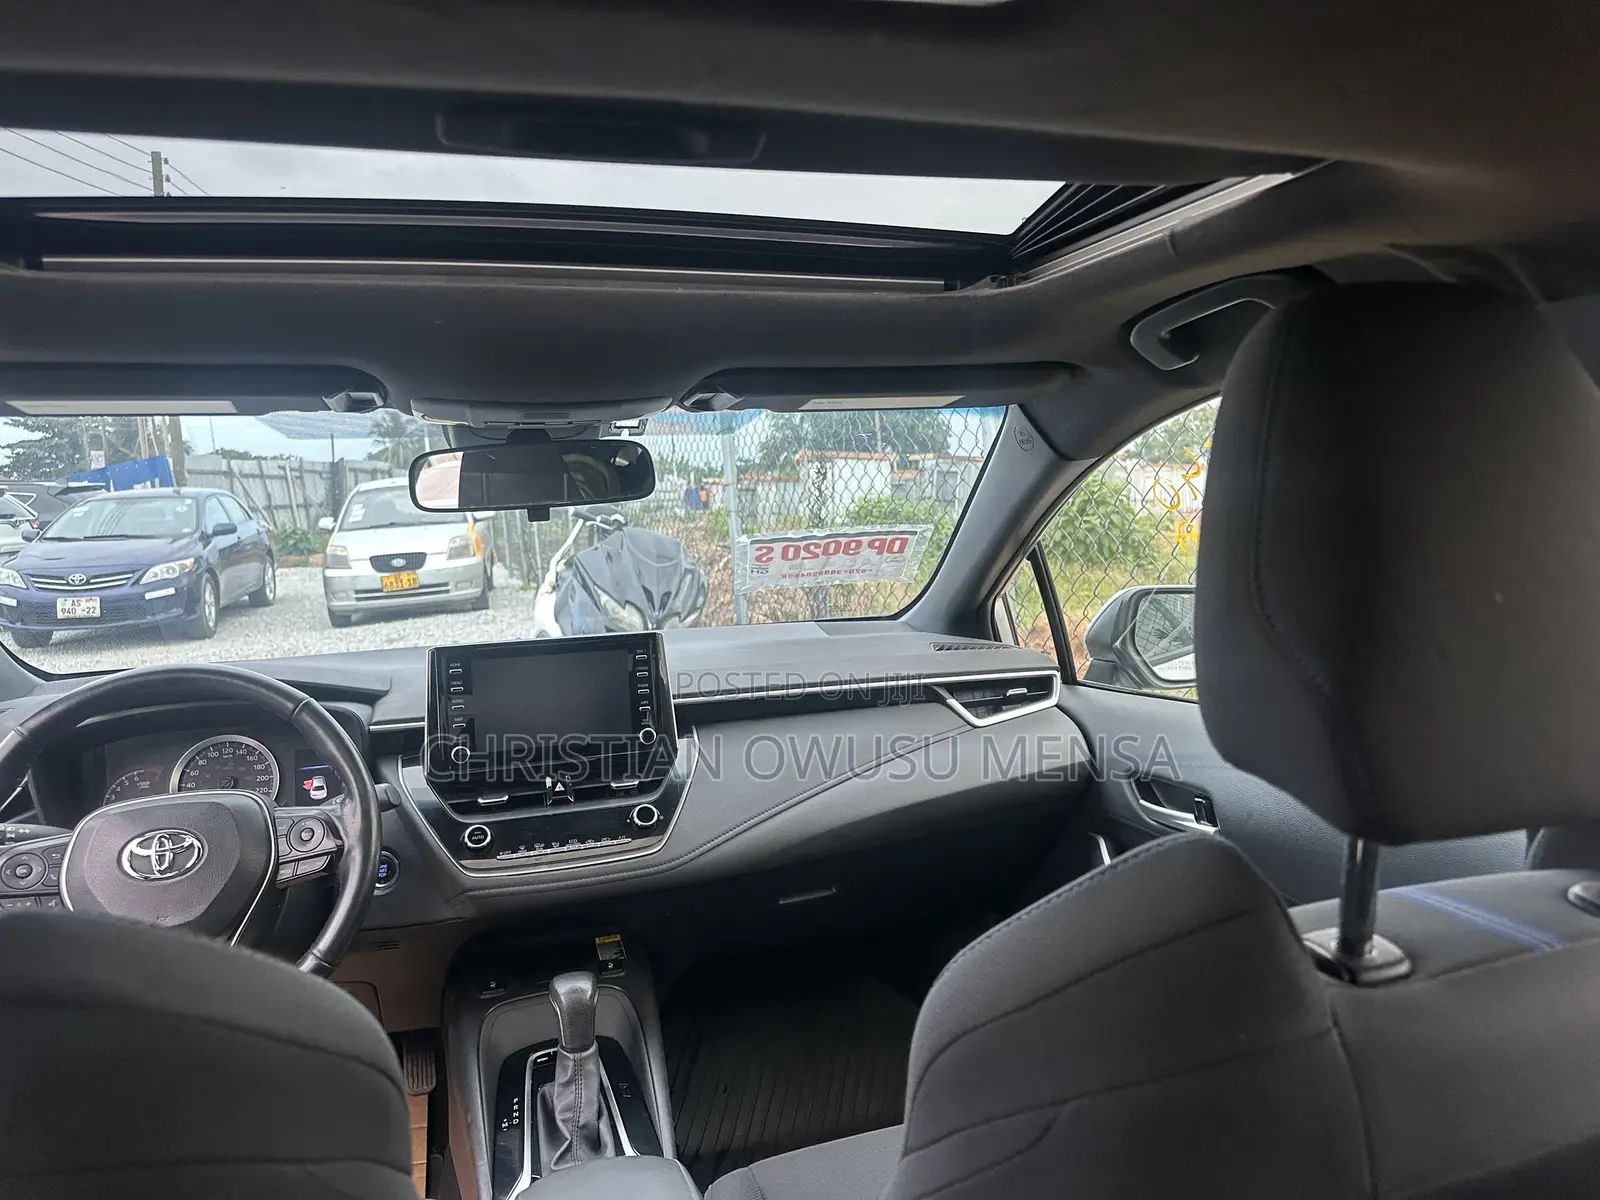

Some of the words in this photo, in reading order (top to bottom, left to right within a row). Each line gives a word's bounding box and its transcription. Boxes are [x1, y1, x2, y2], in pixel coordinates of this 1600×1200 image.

[71, 599, 82, 607] AS
[60, 607, 77, 615] 940
[256, 774, 270, 782] 200
